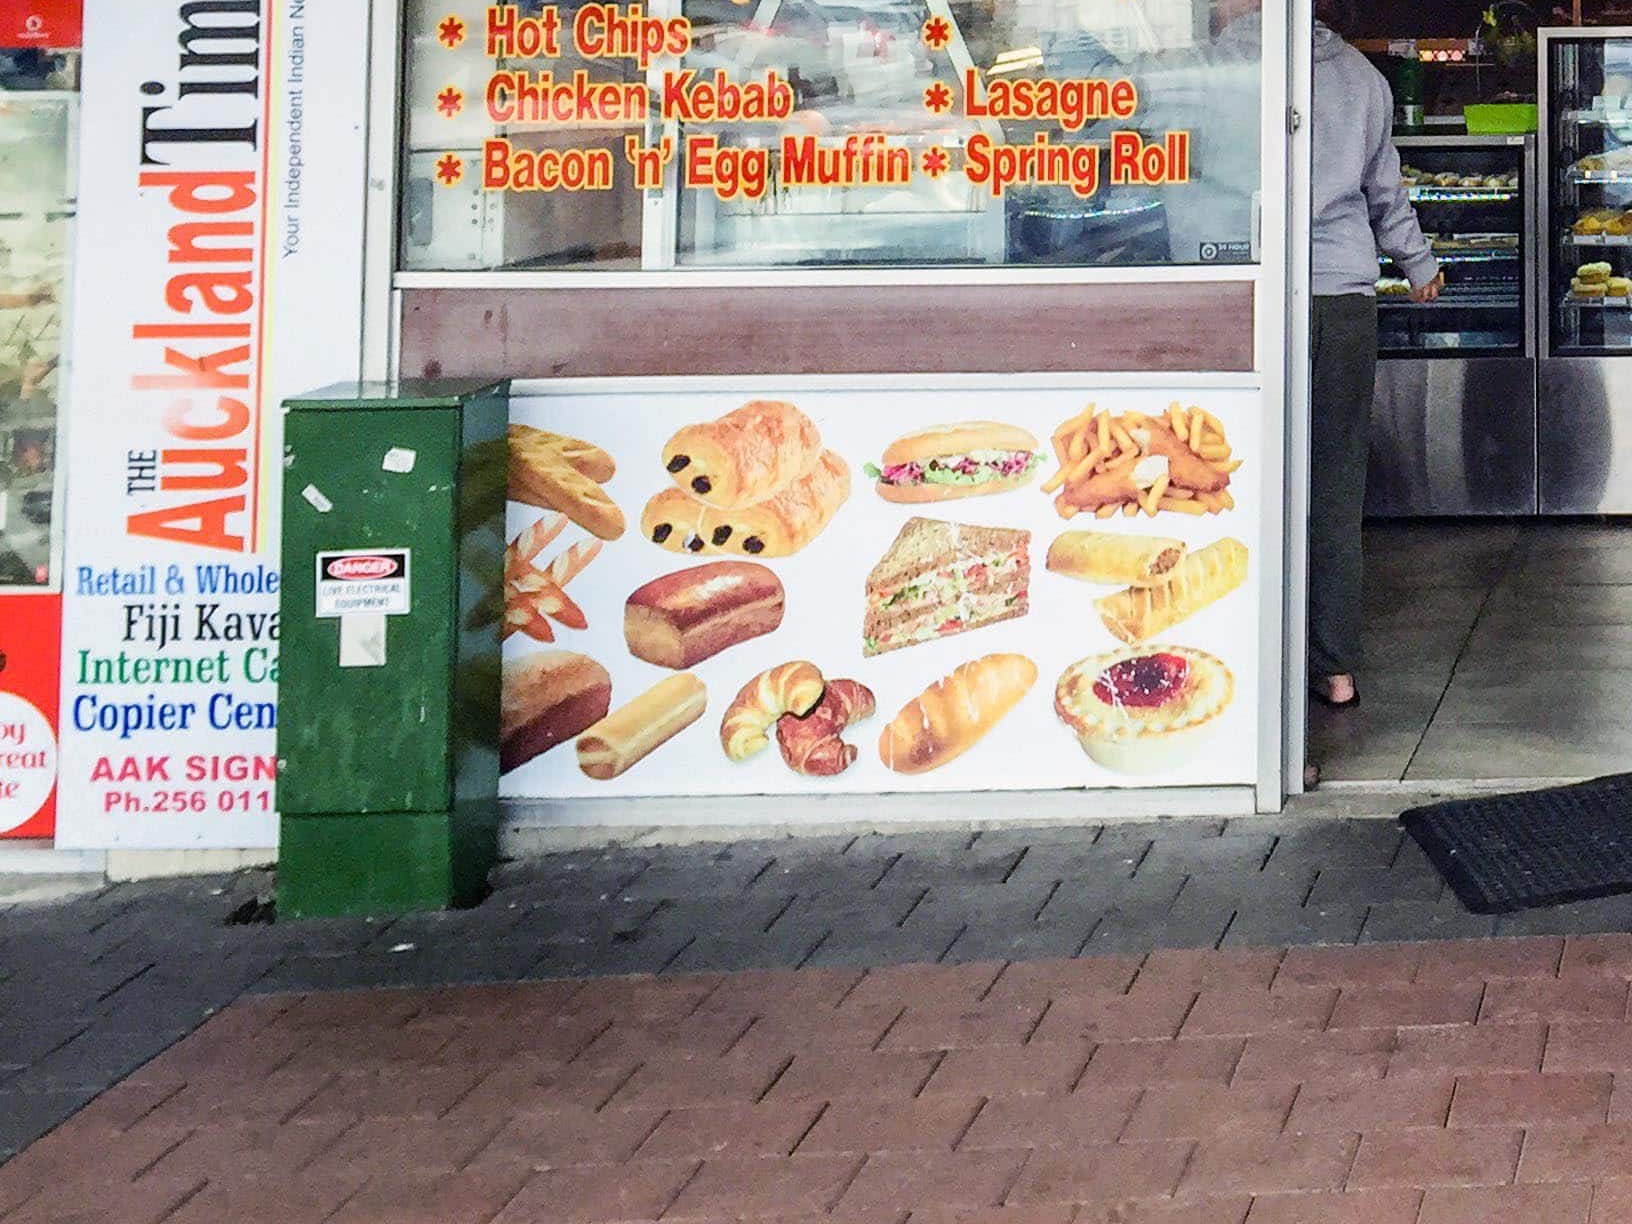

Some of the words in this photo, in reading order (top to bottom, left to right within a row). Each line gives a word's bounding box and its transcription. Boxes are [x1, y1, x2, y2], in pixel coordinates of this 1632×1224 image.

[288, 25, 304, 84] Indian
[486, 6, 561, 56] Hot
[575, 3, 692, 69] Chips
[485, 69, 649, 123] Chicken
[662, 69, 793, 122] Kebab
[963, 67, 1137, 130] Lasagne
[284, 90, 304, 209] Independent
[483, 138, 612, 189] Bacon
[686, 136, 770, 199] Egg
[782, 134, 912, 187] Muffin
[963, 132, 1100, 198] Spring
[1110, 132, 1190, 186] Roll
[282, 216, 299, 260] Your
[128, 450, 156, 495] THE
[76, 564, 155, 595] Retail
[164, 564, 185, 595] &
[195, 564, 280, 594] Whole
[332, 561, 391, 575] DANGER
[346, 583, 400, 595] ELECTRICAL
[335, 597, 389, 609] EQUIPMENT
[122, 603, 181, 650] Fiji
[194, 604, 280, 641] Kava
[77, 649, 231, 684] Internet
[73, 693, 196, 739] Copier
[209, 692, 276, 730] Cen
[90, 756, 170, 782] AAK
[185, 755, 277, 782] SIGN
[104, 790, 206, 813] Ph.256
[217, 789, 269, 812] 011
